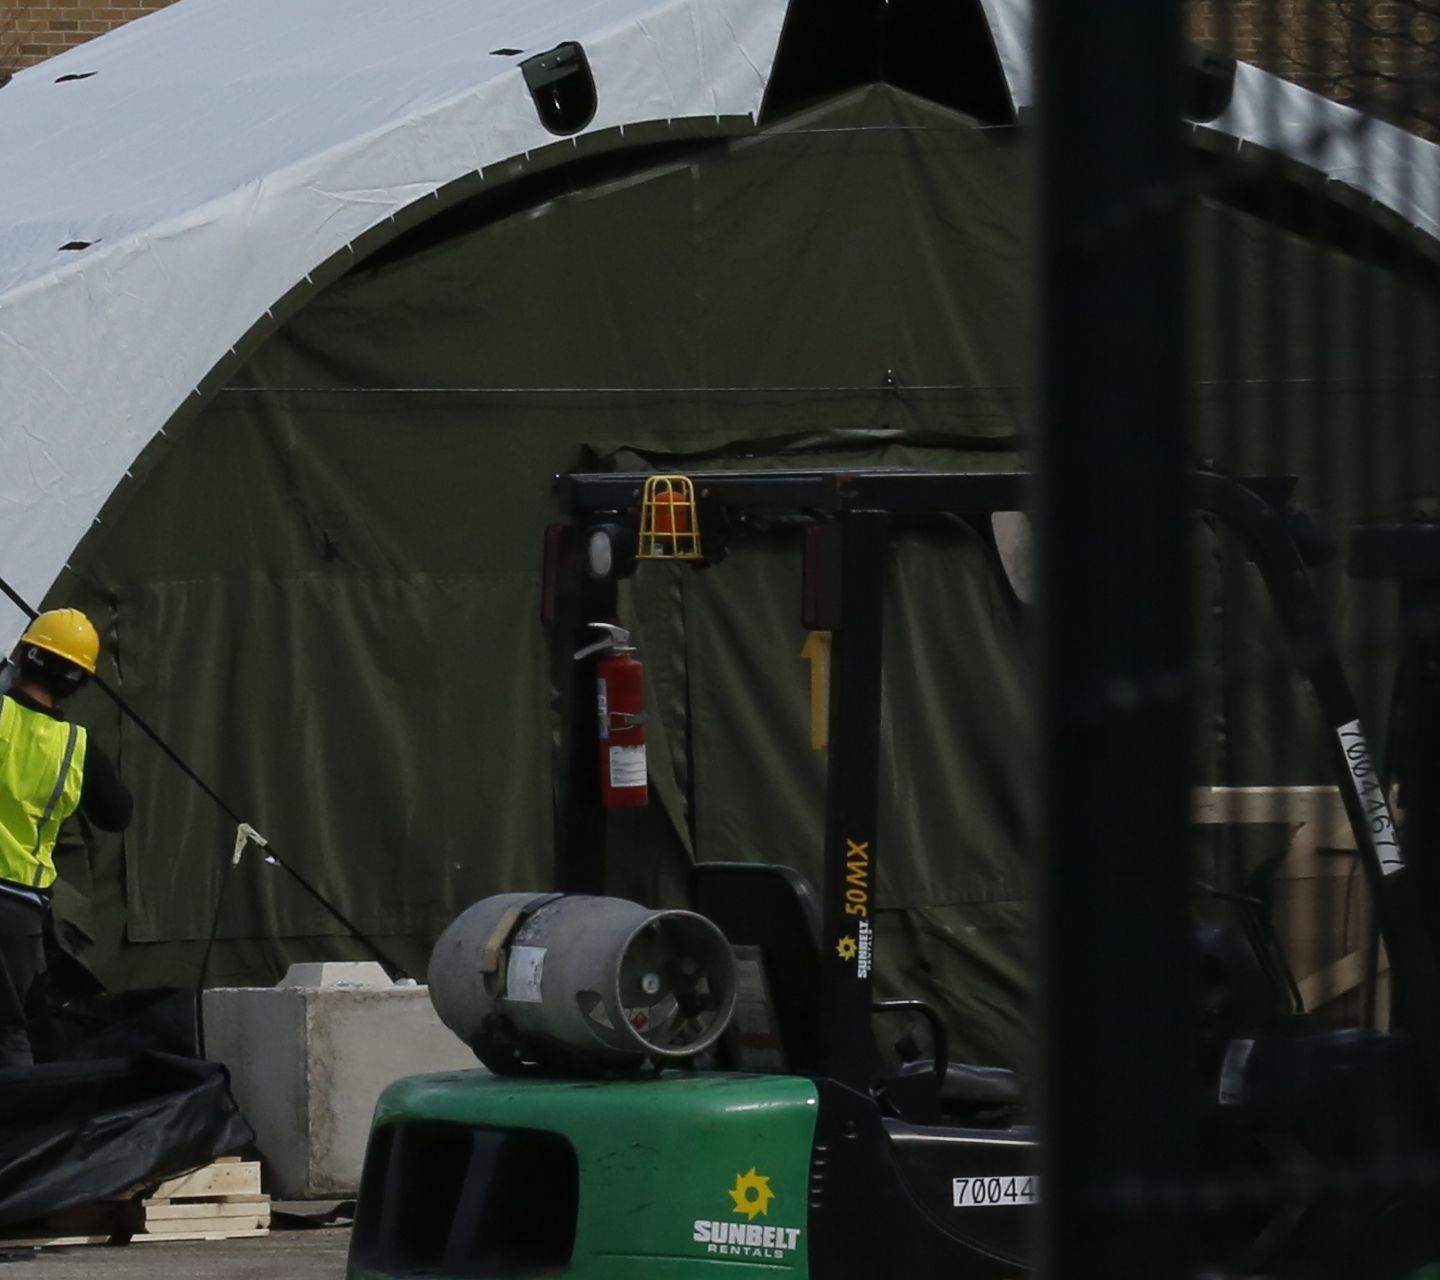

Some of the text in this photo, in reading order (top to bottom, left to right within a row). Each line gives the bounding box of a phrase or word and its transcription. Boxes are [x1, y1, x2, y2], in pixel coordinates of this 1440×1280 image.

[845, 838, 869, 917] 50MX
[857, 920, 869, 979] SUNBELT
[692, 1219, 801, 1251] SUNBELT
[707, 1243, 784, 1259] RENTALS
